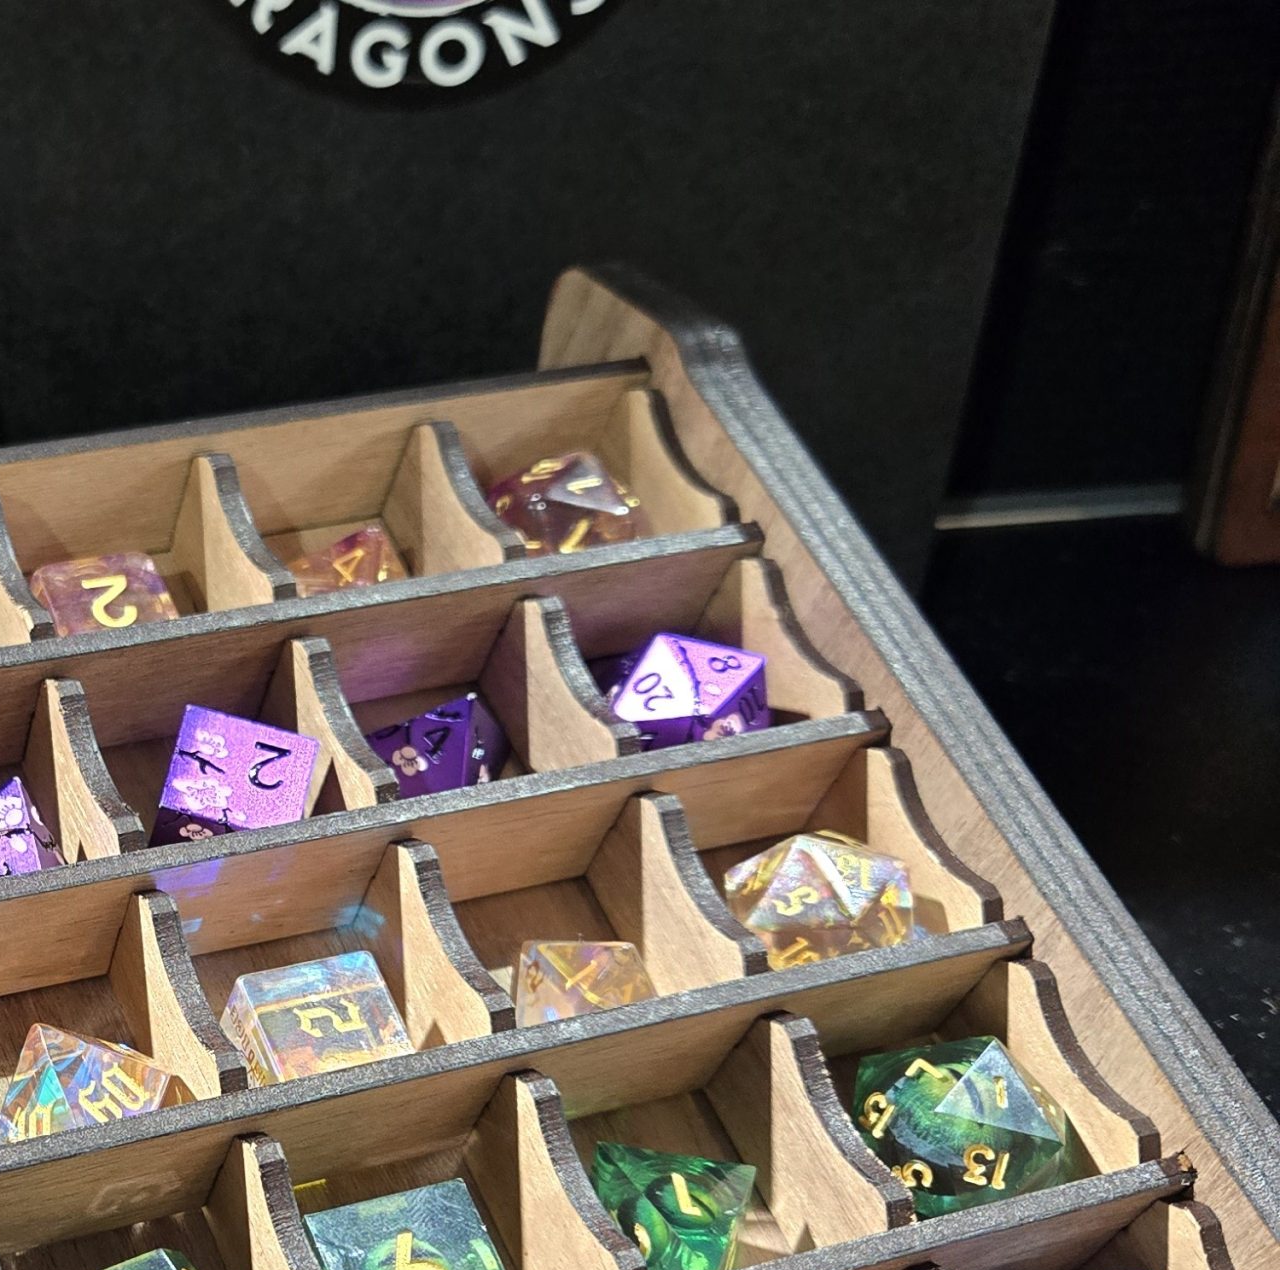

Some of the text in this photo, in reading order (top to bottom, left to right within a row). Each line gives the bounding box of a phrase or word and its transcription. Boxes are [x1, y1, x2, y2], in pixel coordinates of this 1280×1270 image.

[229, 0, 606, 88] AGON
[81, 574, 138, 628] 2
[708, 655, 742, 673] 8
[632, 672, 675, 711] 20
[247, 741, 292, 790] 2
